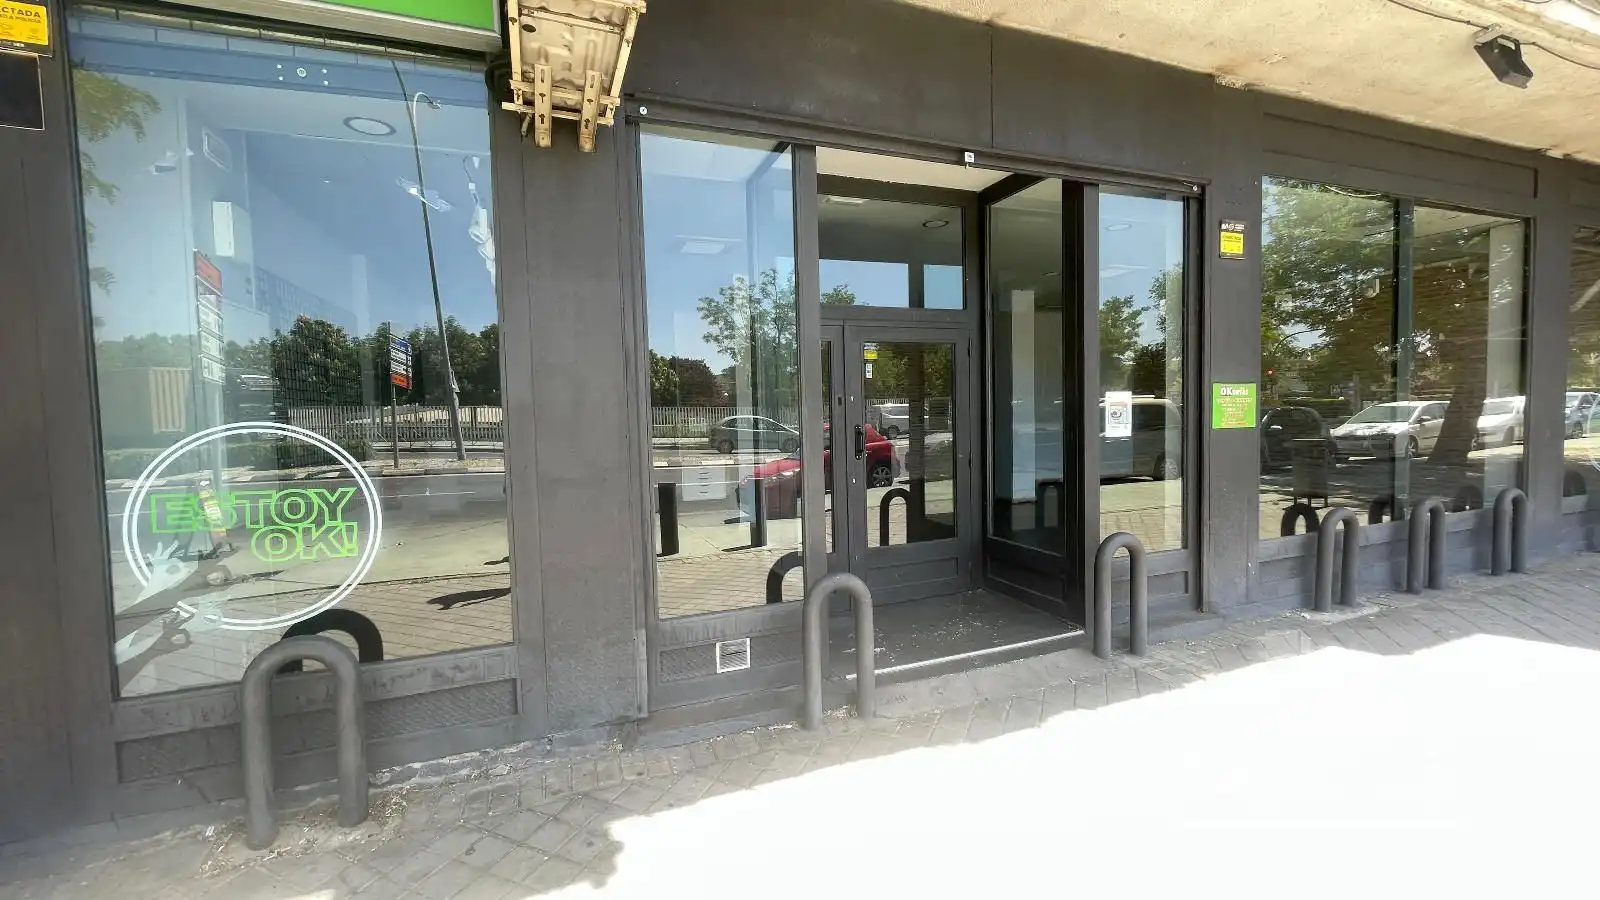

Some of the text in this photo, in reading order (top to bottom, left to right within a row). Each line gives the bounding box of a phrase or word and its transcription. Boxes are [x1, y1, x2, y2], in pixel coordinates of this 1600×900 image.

[0, 6, 40, 17] CTADA
[151, 487, 358, 534] ESTOY
[251, 521, 359, 562] OK!
